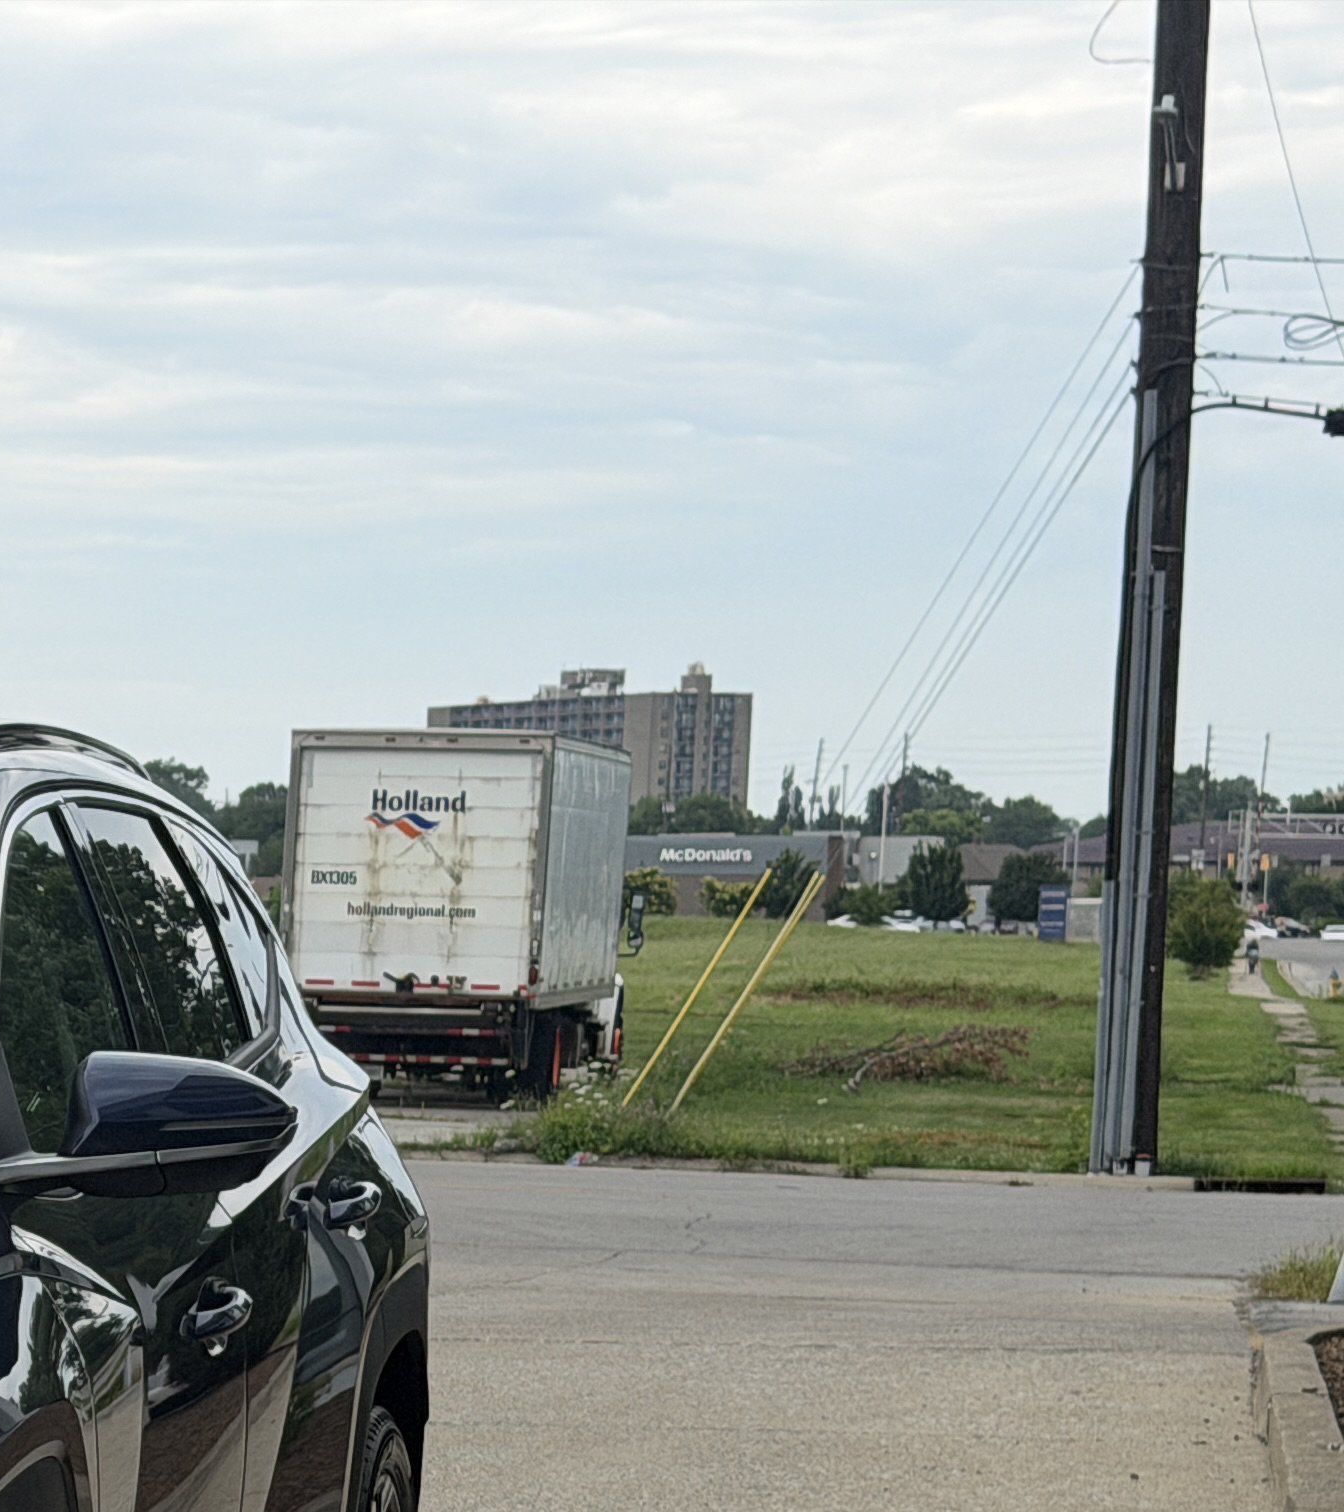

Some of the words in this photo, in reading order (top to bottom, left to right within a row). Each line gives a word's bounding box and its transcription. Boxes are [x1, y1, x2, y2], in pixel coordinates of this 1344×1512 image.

[371, 788, 467, 814] Holland
[659, 847, 753, 863] McDonald's
[310, 869, 358, 885] BX1305
[346, 901, 477, 919] hollandregional.com
